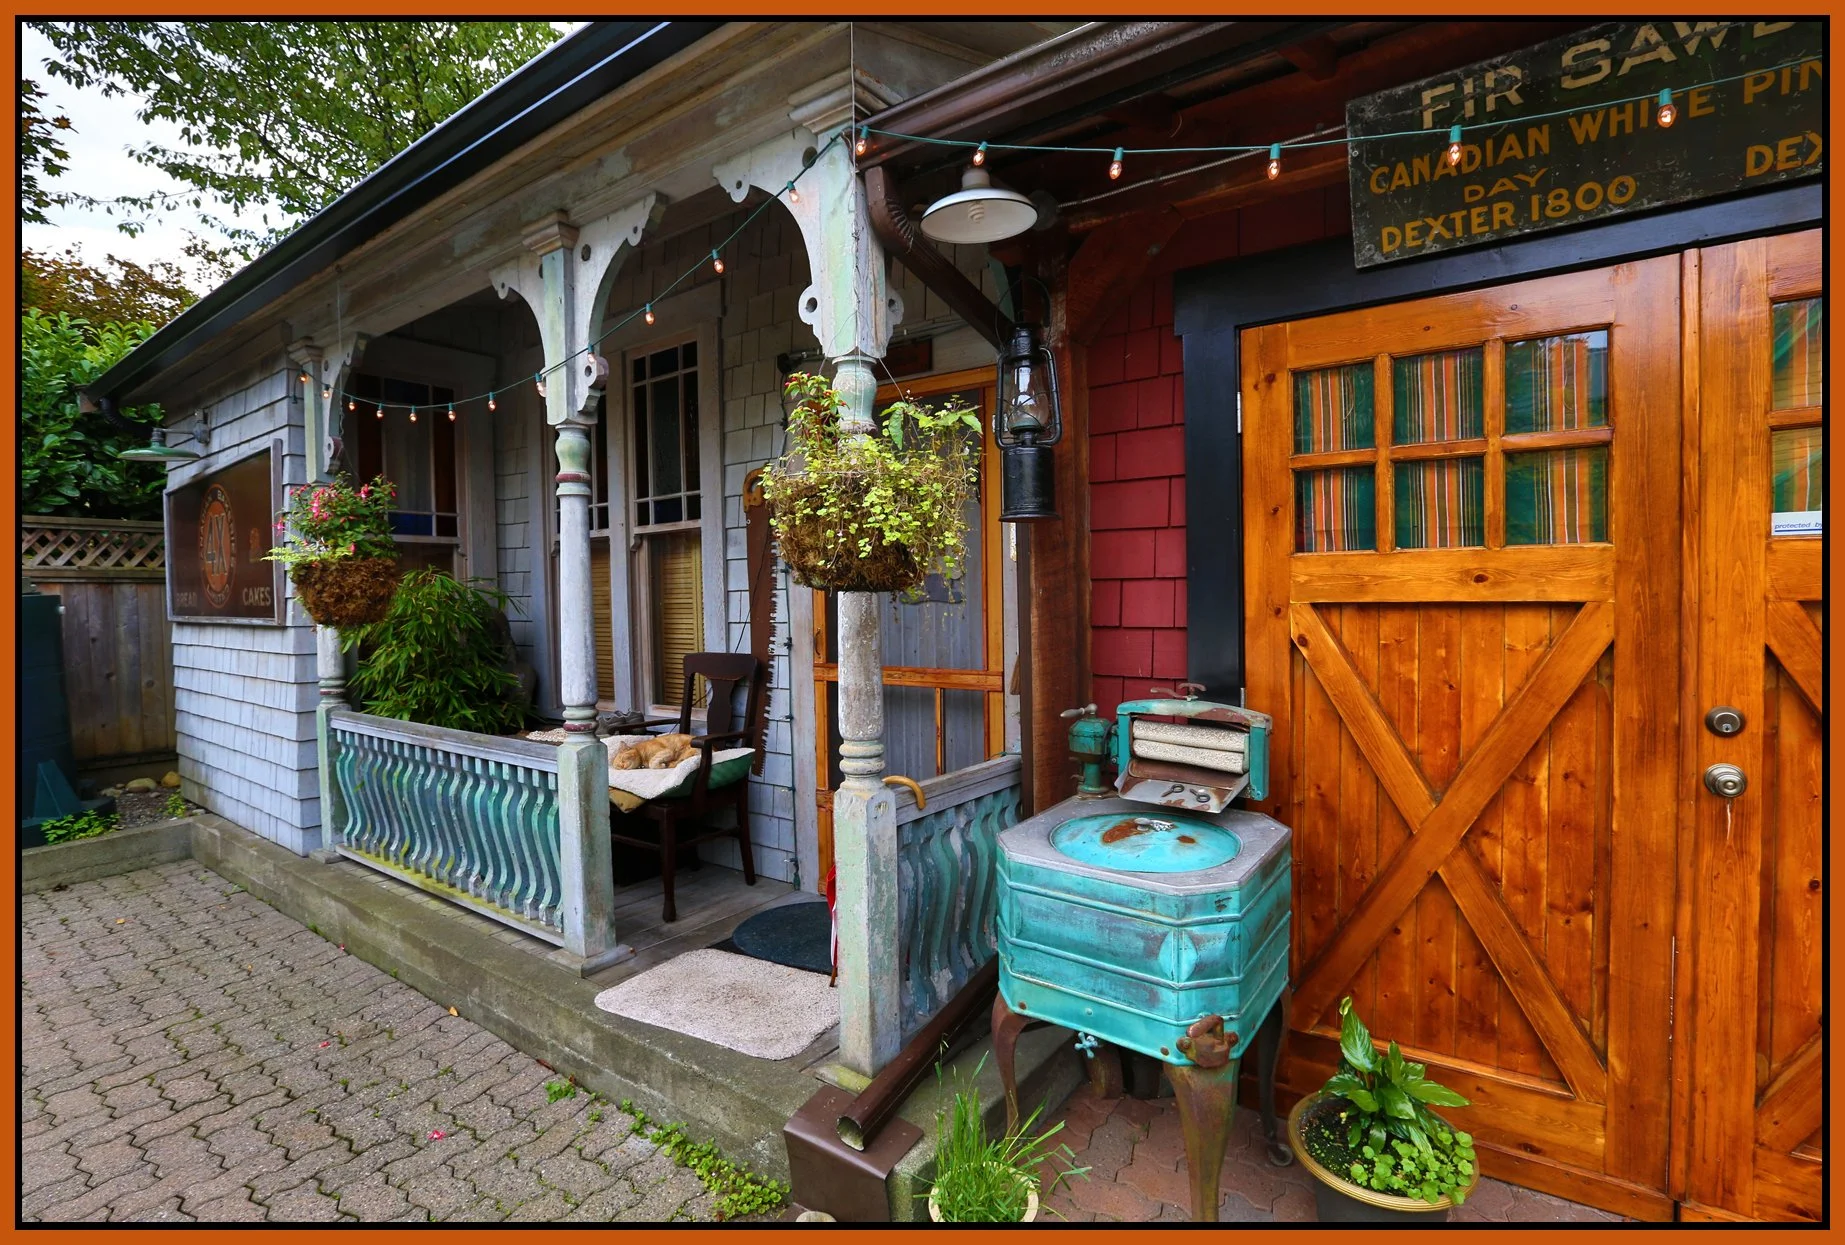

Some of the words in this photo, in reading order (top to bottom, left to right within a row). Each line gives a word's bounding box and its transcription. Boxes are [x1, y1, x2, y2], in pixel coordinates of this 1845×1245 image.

[1421, 66, 1524, 129] FIR
[1561, 22, 1795, 91] SAW
[1370, 125, 1549, 195] CANADIAN
[1569, 85, 1716, 142] WHIE
[1381, 201, 1516, 254] DEXTER
[1530, 174, 1637, 219] 1800
[1464, 168, 1548, 203] DAY
[206, 513, 228, 577] 4X
[242, 586, 271, 606] CAKES
